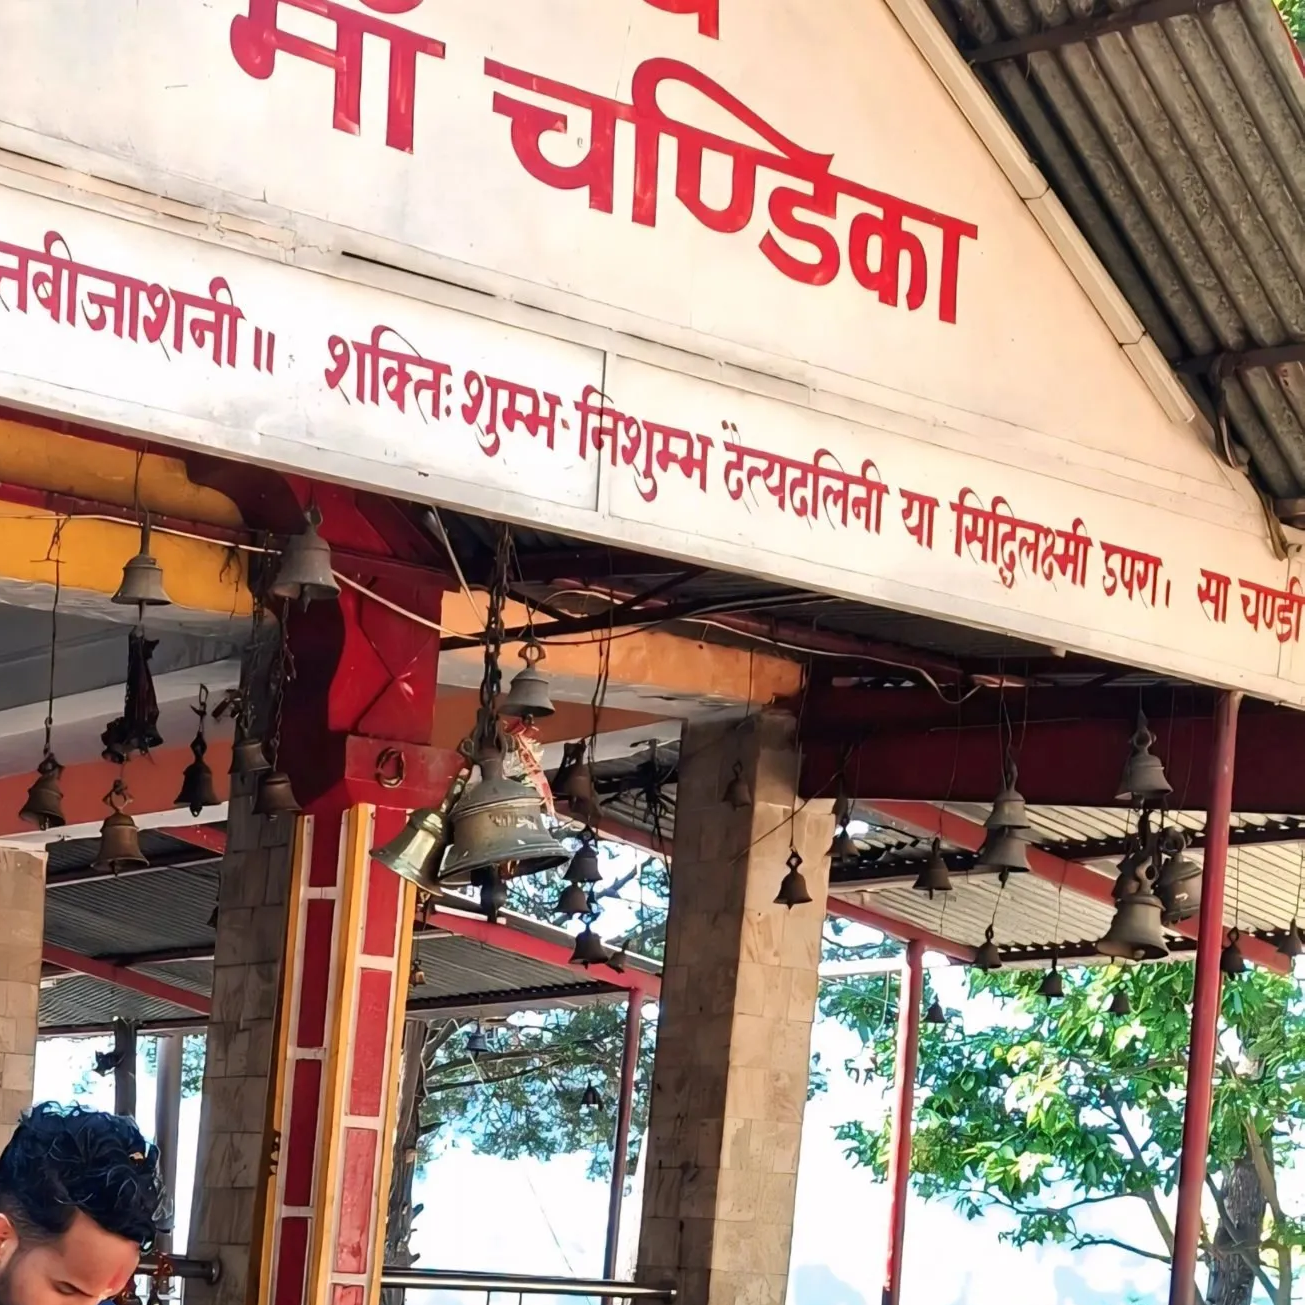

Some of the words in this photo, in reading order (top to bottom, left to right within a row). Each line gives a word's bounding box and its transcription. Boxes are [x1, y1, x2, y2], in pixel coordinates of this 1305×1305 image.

[484, 57, 978, 325] चण्डिका
[899, 488, 940, 550] या
[1197, 568, 1232, 622] सा
[1238, 575, 1305, 643] चण्डी
